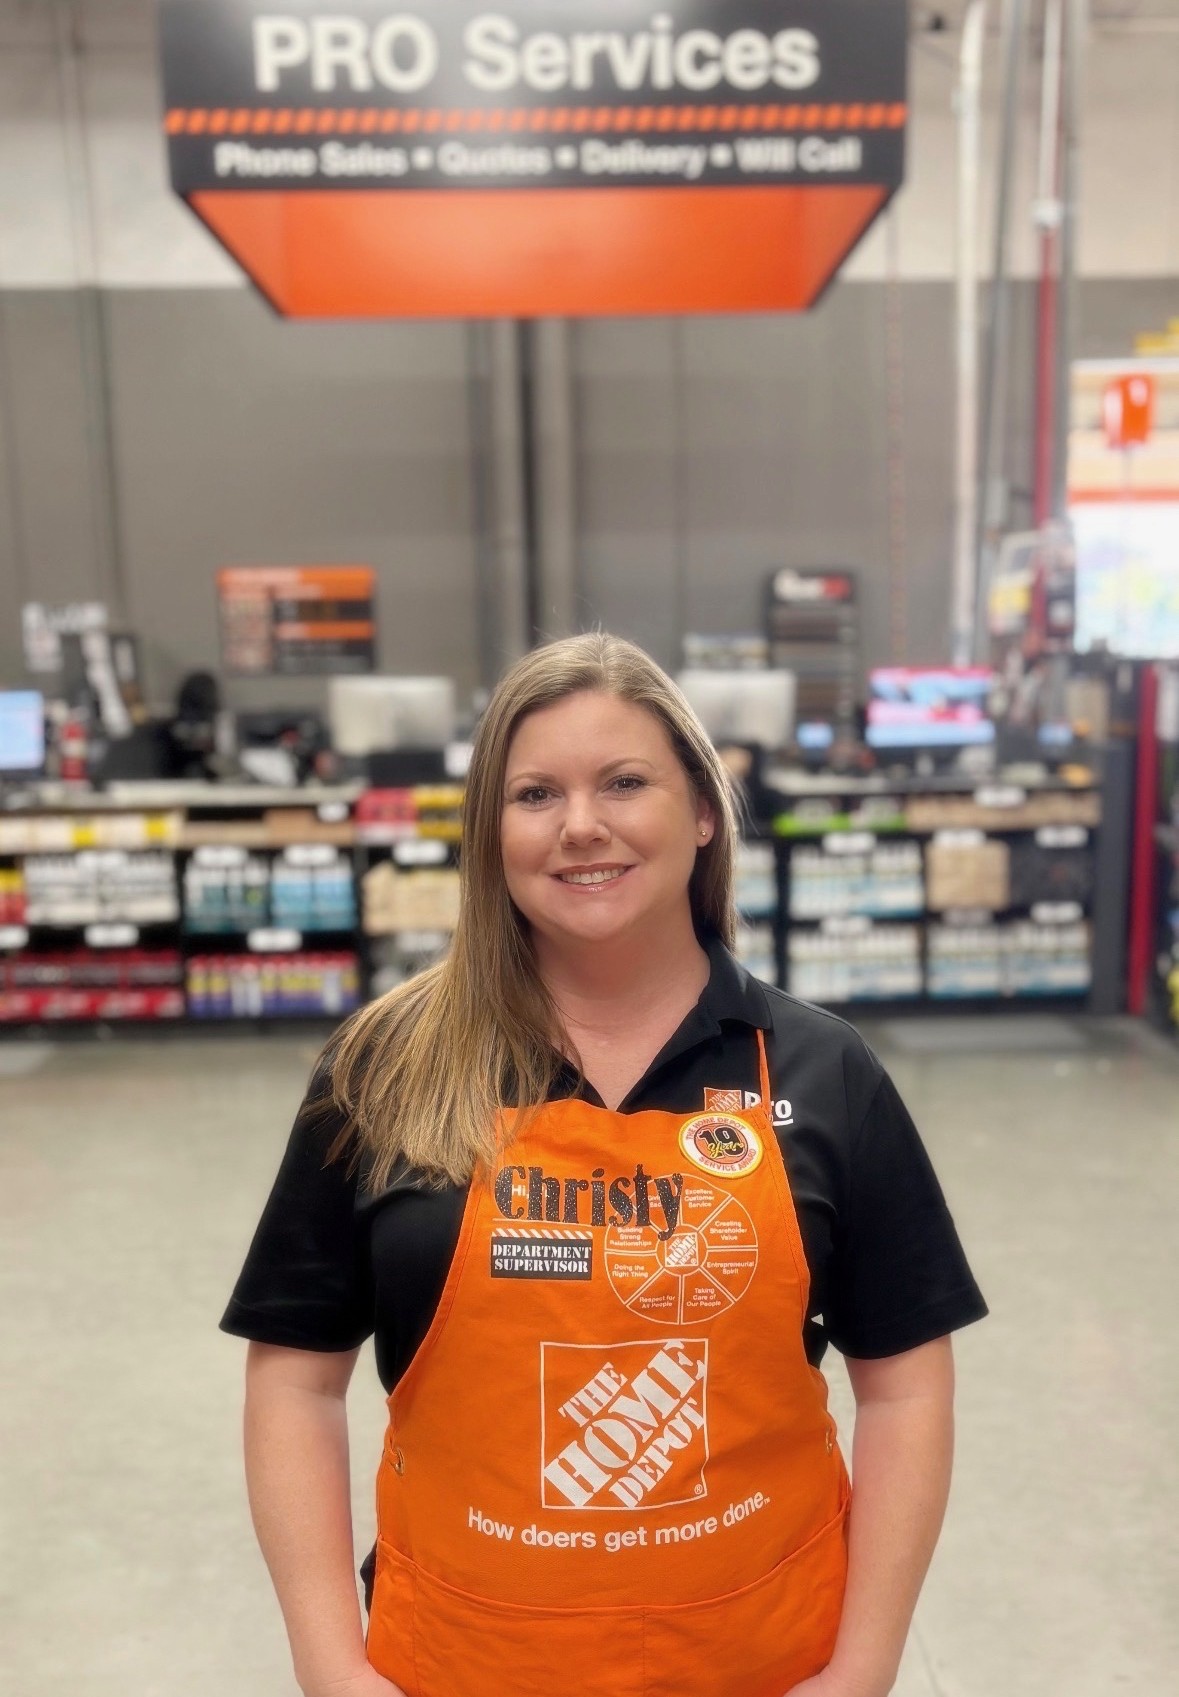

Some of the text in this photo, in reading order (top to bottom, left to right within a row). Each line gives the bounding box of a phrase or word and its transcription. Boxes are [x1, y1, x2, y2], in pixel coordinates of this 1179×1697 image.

[252, 13, 820, 92] PRO Services
[215, 136, 862, 180] Phone Sales Quotes Delivery Will Call
[694, 1116, 716, 1130] HOME
[717, 1117, 746, 1131] DEPOT
[699, 1148, 757, 1172] SERVICE AWARD
[494, 1163, 683, 1241] Christy
[684, 1195, 715, 1203] Customer
[715, 1220, 742, 1229] Creating
[617, 1226, 644, 1234] Building
[710, 1227, 747, 1235] Shareholder
[619, 1233, 641, 1242] Strong
[609, 1239, 653, 1247] Relationships
[492, 1244, 592, 1259] DEPARTMENT
[494, 1258, 589, 1273] SUPERVISOR
[614, 1263, 633, 1271] Doing
[706, 1261, 755, 1269] Entrepreneurial
[612, 1270, 649, 1279] Right Thing
[722, 1267, 739, 1275] Spirit
[694, 1287, 715, 1295] Taking
[639, 1294, 676, 1304] Respect for
[651, 1301, 673, 1309] People
[700, 1300, 722, 1308] People
[558, 1361, 628, 1428] THE
[544, 1339, 706, 1507] HOME
[608, 1397, 705, 1508] DEPOT
[468, 1506, 515, 1541] How
[520, 1524, 596, 1548] doers
[604, 1526, 648, 1552] get
[655, 1516, 718, 1545] more
